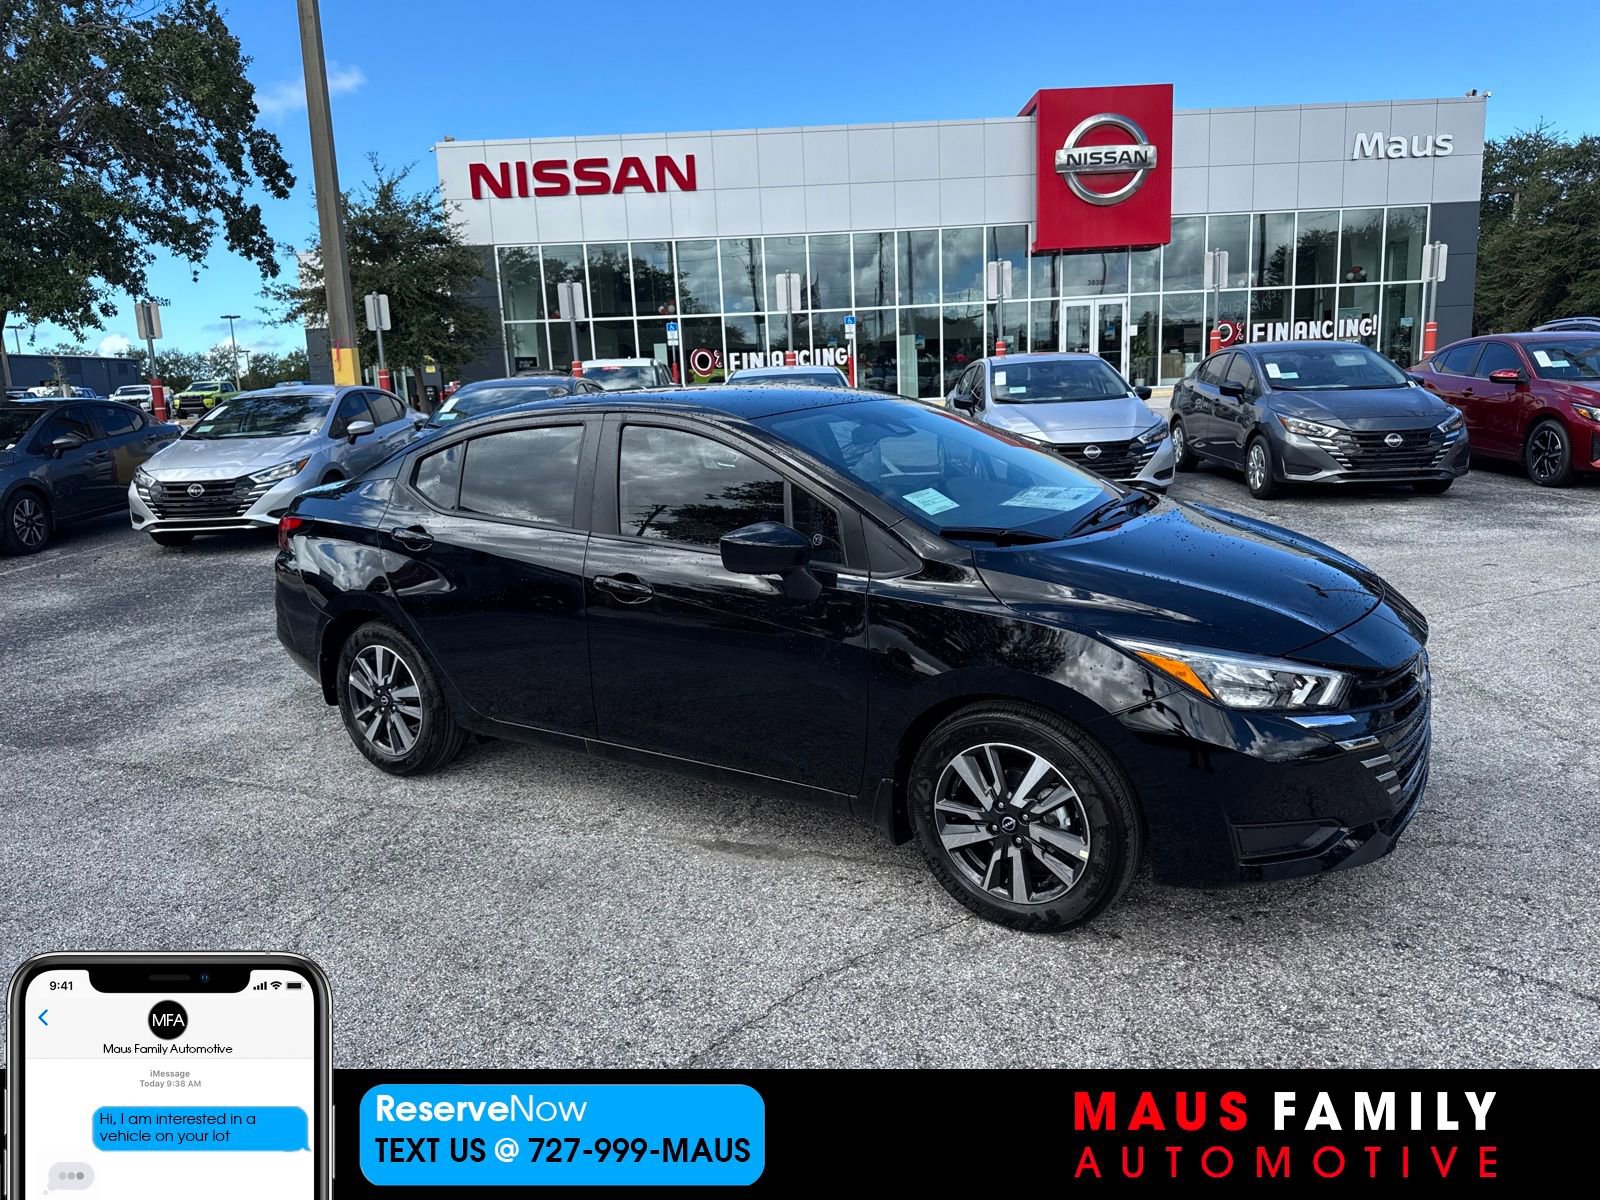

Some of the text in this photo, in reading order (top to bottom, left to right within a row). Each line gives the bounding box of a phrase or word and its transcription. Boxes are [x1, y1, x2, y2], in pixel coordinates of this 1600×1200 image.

[1065, 149, 1149, 169] NISSAN
[1352, 131, 1454, 160] Maus
[469, 154, 697, 200] NISSAN
[1252, 314, 1378, 342] FINANCING!
[690, 348, 724, 377] 0%
